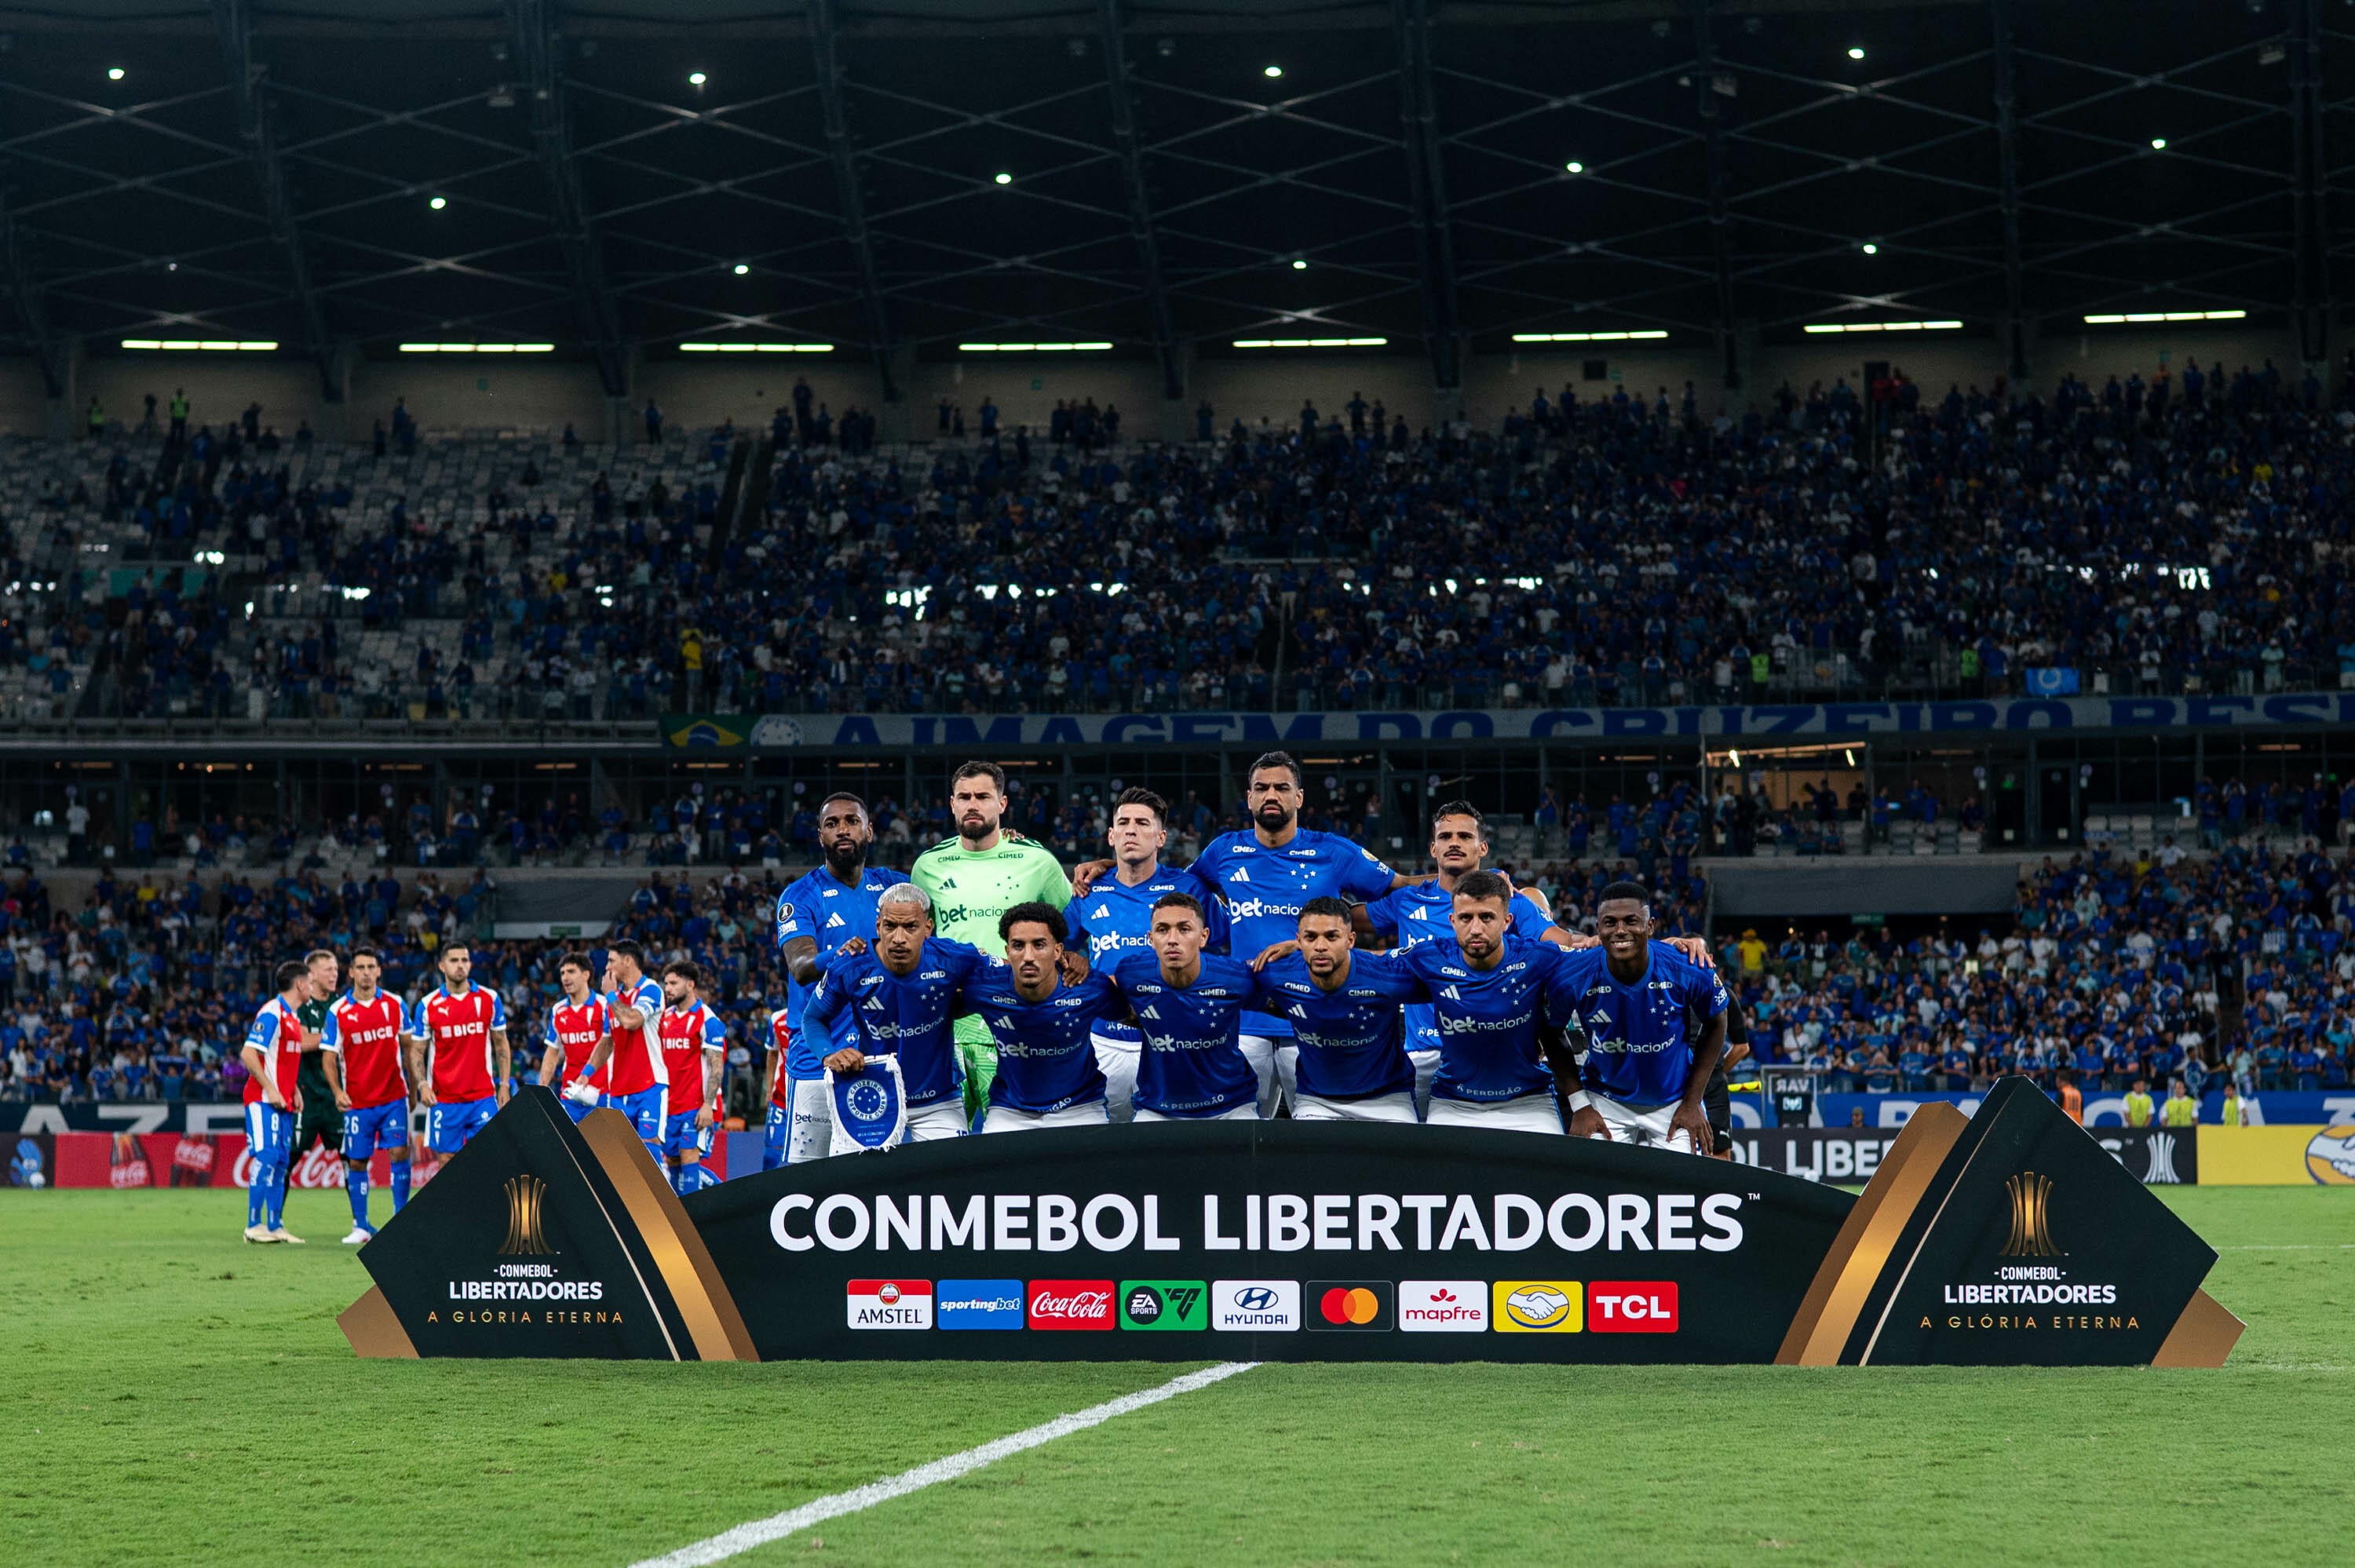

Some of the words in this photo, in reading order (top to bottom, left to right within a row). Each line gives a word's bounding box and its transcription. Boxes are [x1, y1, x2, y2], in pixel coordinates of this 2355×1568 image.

[834, 715, 881, 745] A
[939, 904, 1009, 924] betnacio
[1229, 897, 1303, 918] betnacio
[920, 970, 946, 980] CIMED
[1441, 966, 1467, 977] CIMED
[860, 975, 885, 986] CIMED
[1284, 982, 1311, 993] CIMED
[1648, 981, 1673, 990] CIMED
[1137, 984, 1162, 994] CIMED
[1586, 985, 1612, 997] CIMED
[992, 995, 1017, 1005] CIMED
[1054, 997, 1082, 1007] CIMED
[363, 1025, 393, 1043] BICE
[453, 1021, 484, 1037] BICE
[568, 1030, 596, 1045] BICE
[666, 1038, 691, 1049] BICE
[271, 1112, 279, 1132] 8
[433, 1110, 444, 1129] 2
[767, 1107, 783, 1125] 15
[344, 1116, 360, 1135] 26
[770, 1193, 1181, 1252] CONMEBOL
[1203, 1193, 1743, 1252] LIBERTADORES
[449, 1281, 603, 1300] LIBERTADORES
[1944, 1285, 2116, 1304] LIBERTADORES
[940, 1297, 1020, 1312] sportingbet
[1031, 1291, 1112, 1318] Coca-Cola
[1131, 1293, 1157, 1307] EA
[1596, 1295, 1670, 1318] TCL
[428, 1311, 439, 1323] A
[452, 1308, 532, 1324] GLÓRIA
[546, 1311, 624, 1324] ETERNA
[857, 1308, 922, 1324] AMSTEL
[1225, 1314, 1288, 1325] HYUNDAI
[1405, 1306, 1481, 1323] mapfre
[1920, 1316, 1932, 1329] A
[1948, 1313, 2037, 1329] GLÓRIA
[2053, 1316, 2140, 1329] ETERNA
